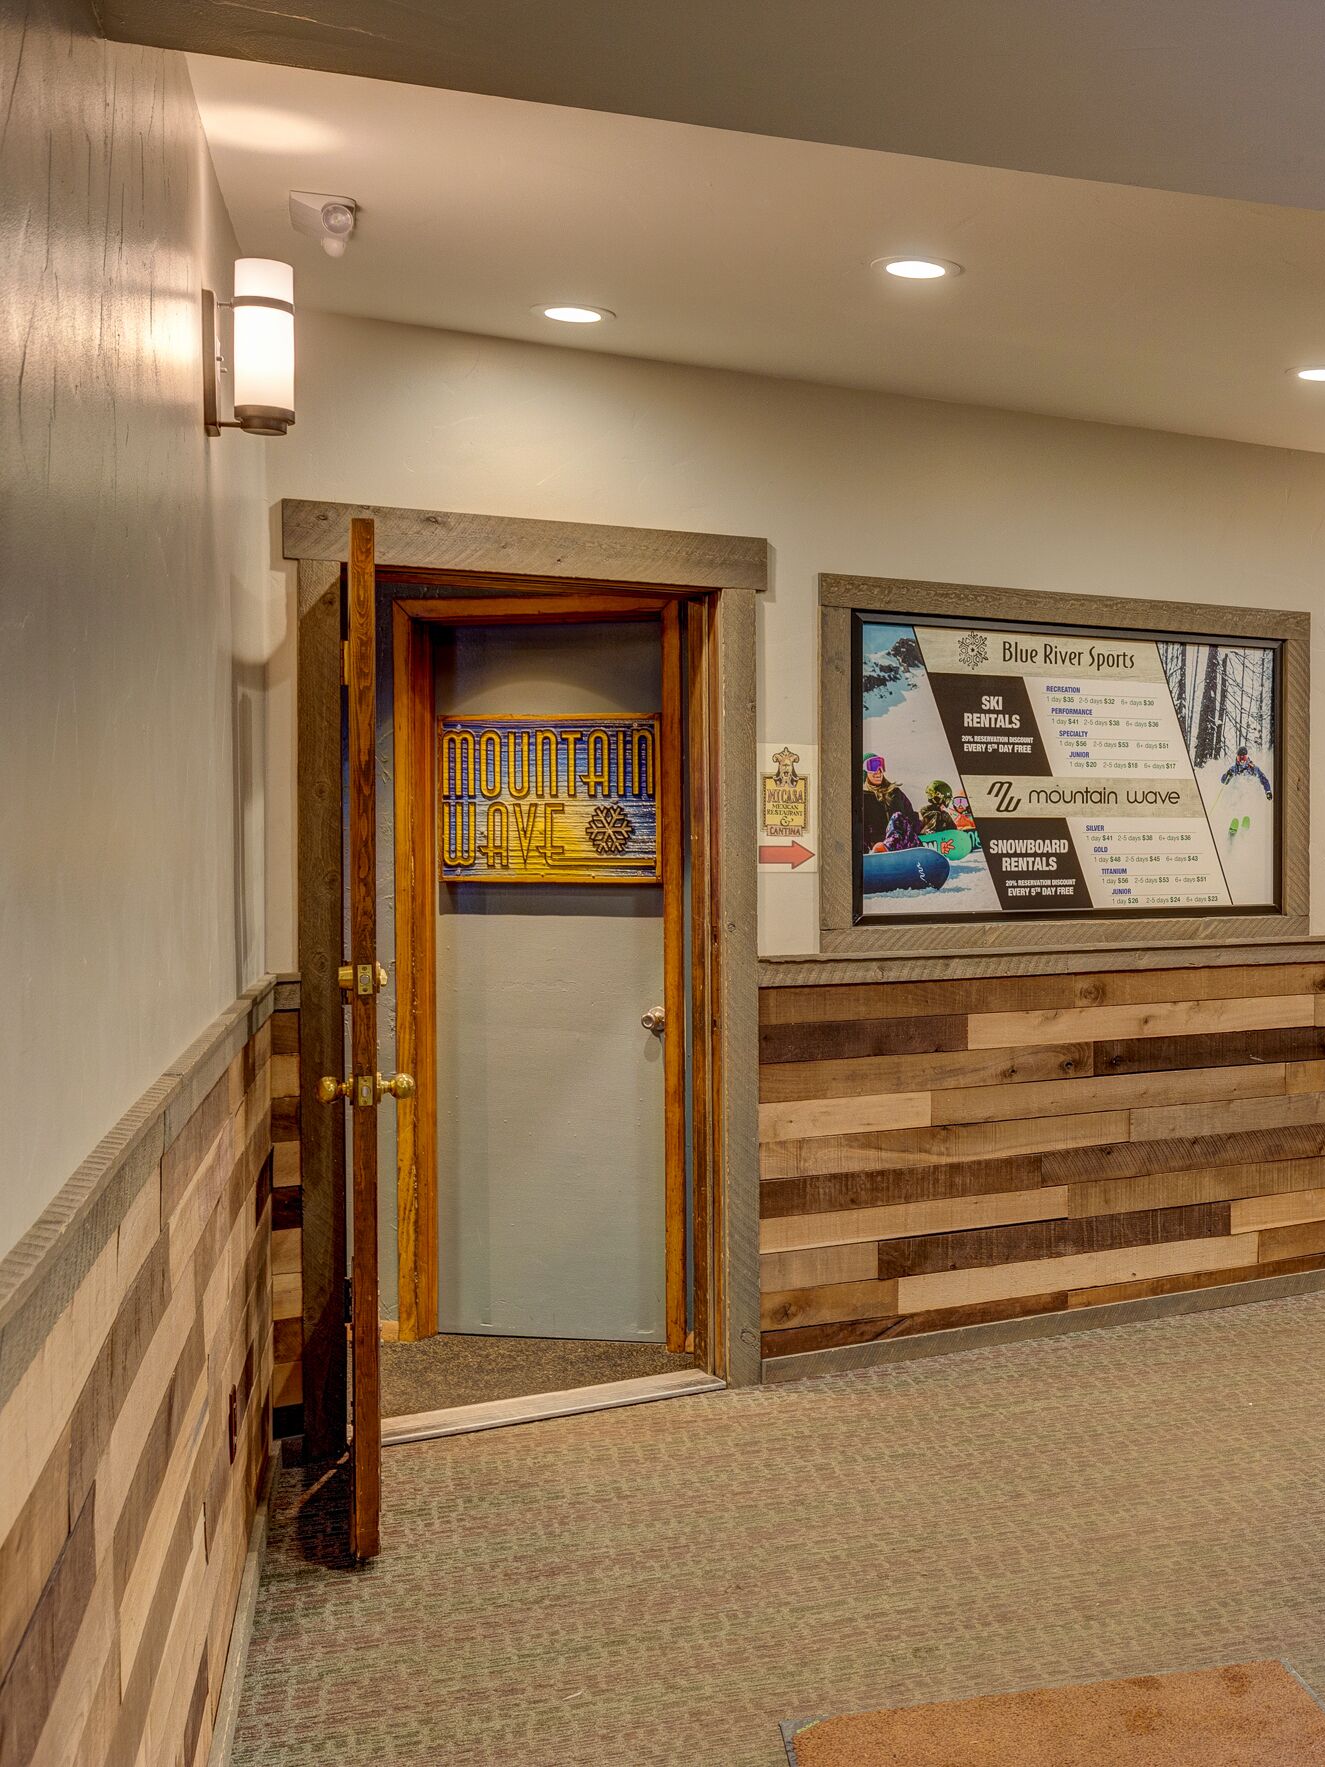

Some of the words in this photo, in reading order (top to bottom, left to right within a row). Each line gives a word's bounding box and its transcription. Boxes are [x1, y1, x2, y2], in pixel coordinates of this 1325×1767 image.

[1002, 641, 1038, 664] Blue
[1043, 643, 1084, 667] River
[1088, 646, 1135, 672] Sports
[981, 695, 1003, 711] SKI
[1089, 698, 1103, 706] days
[1051, 708, 1093, 716] PERFORMANCE
[963, 712, 1021, 729] RENTALS
[1094, 720, 1108, 728] days
[1059, 730, 1089, 738] SPECIALTY
[964, 743, 986, 752] EVERY
[999, 744, 1013, 753] DAY
[1014, 745, 1032, 753] FREE
[1063, 740, 1075, 748] day
[1103, 742, 1117, 750] days
[1144, 742, 1158, 750] days
[1069, 751, 1090, 759] JUNIOR
[443, 729, 655, 799] MOUNTAIN
[1074, 761, 1085, 769] day
[1113, 762, 1127, 770] days
[1152, 763, 1166, 771] days
[1028, 787, 1118, 804] mountain
[1126, 790, 1181, 805] wave
[780, 816, 794, 826] &
[443, 801, 566, 868] WAVE
[769, 826, 801, 836] CANTINA
[1128, 835, 1142, 843] days
[1166, 834, 1180, 842] days
[989, 839, 1069, 853] SNOWBOARD
[1002, 857, 1058, 872] RENTALS
[1098, 856, 1109, 864] day
[1135, 856, 1149, 864] days
[1174, 855, 1187, 864] days
[1106, 878, 1117, 886] day
[1144, 877, 1158, 885] days
[1183, 876, 1196, 884] days
[1008, 888, 1030, 896] EVERY
[1042, 887, 1056, 895] DAY
[1057, 886, 1074, 895] FREE
[1116, 898, 1127, 906] day
[1156, 896, 1169, 905] days
